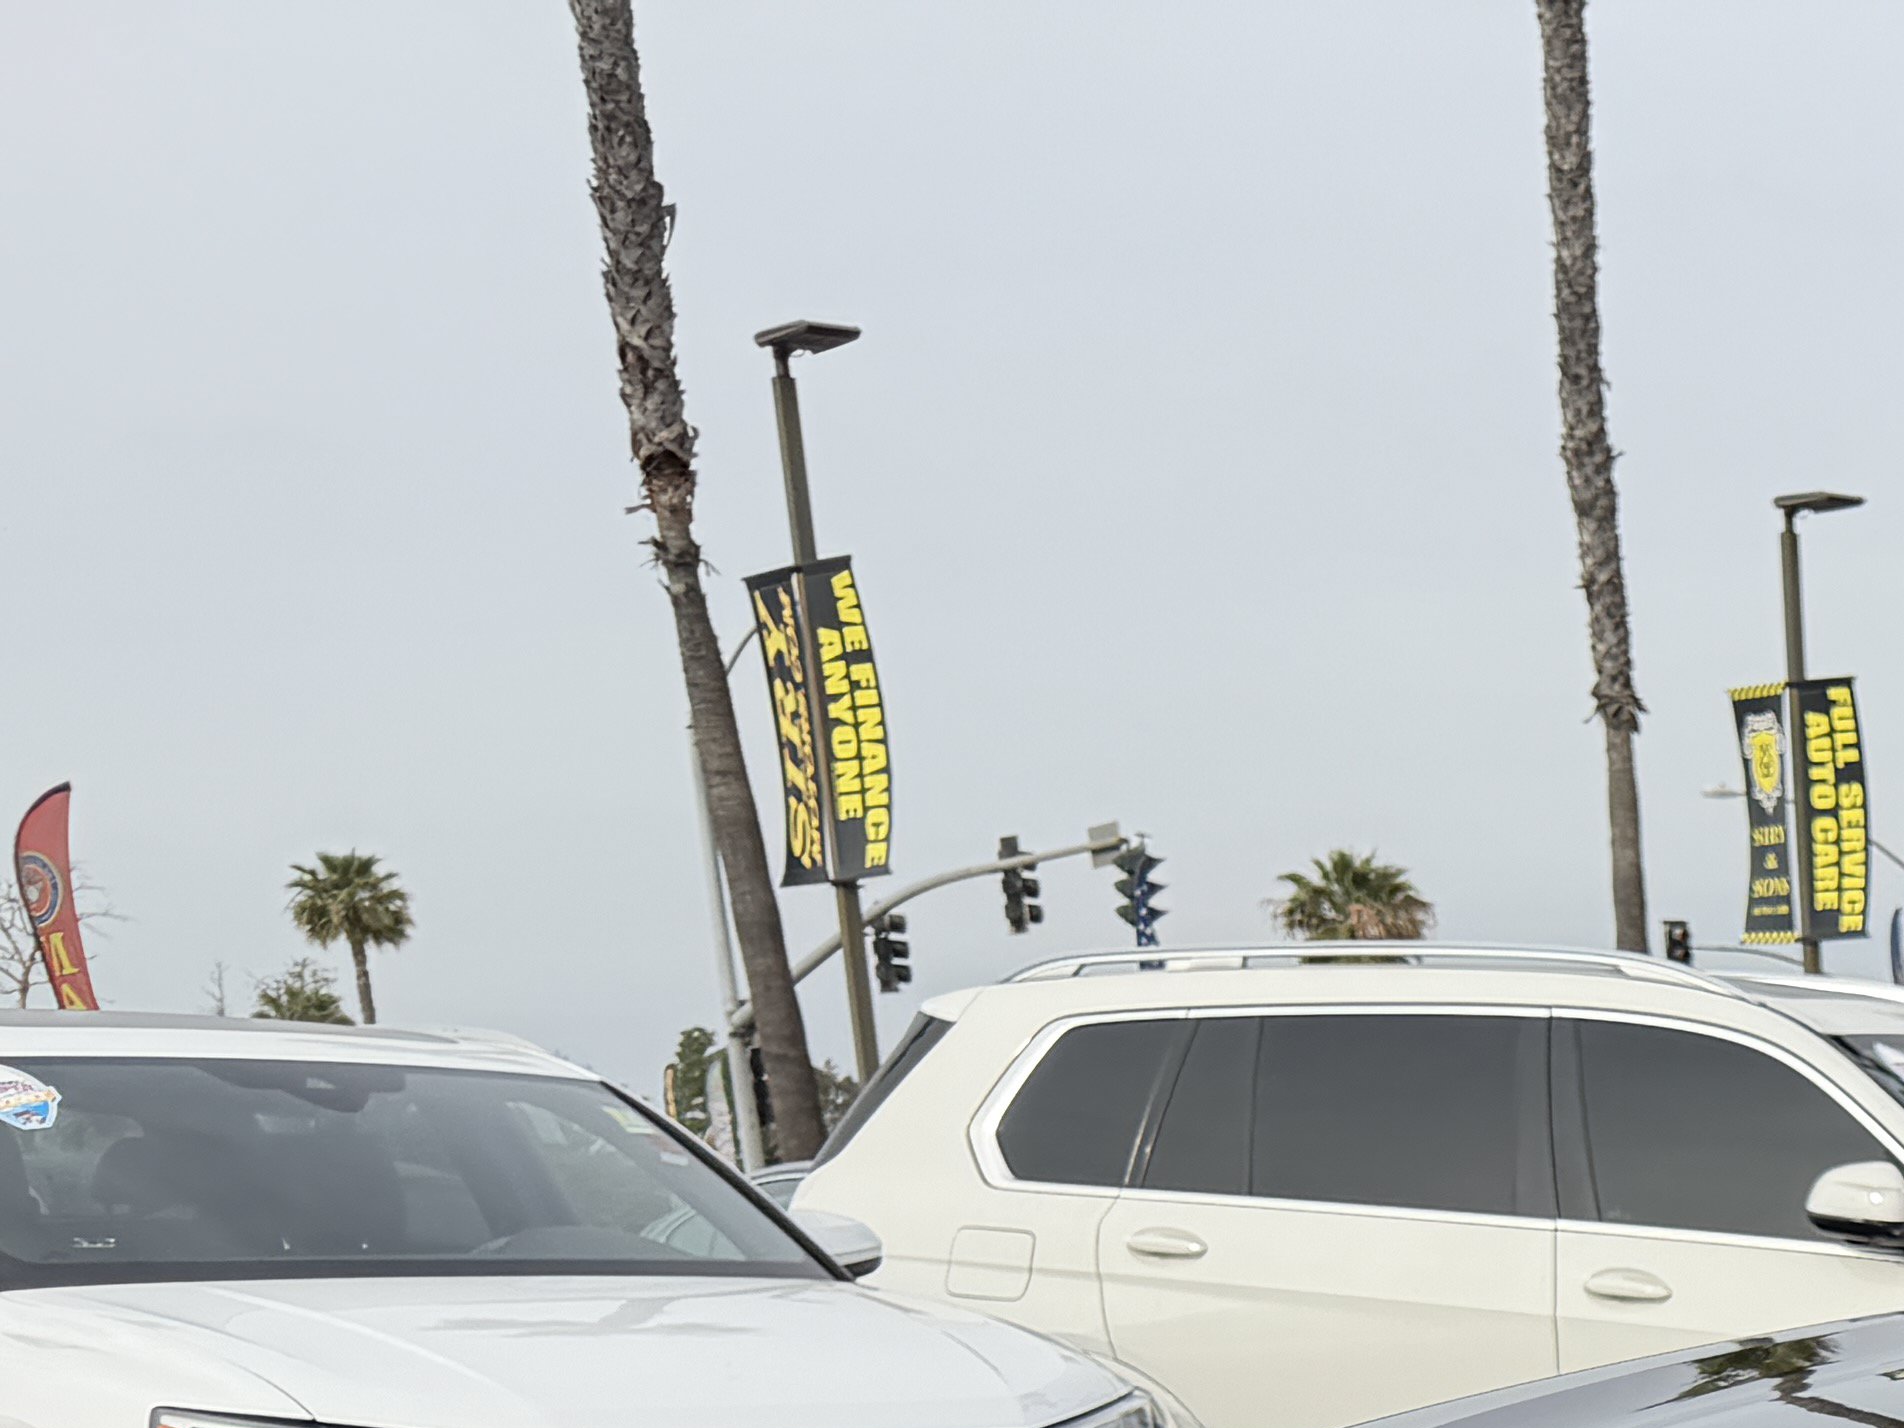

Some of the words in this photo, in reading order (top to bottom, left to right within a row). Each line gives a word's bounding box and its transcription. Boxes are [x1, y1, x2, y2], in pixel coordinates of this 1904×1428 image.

[831, 570, 869, 652] WE
[753, 590, 812, 870] SIRY
[816, 627, 864, 821] ANYONE
[849, 663, 890, 869] FINANCE
[1804, 710, 1837, 810] AUTO
[1826, 686, 1861, 769] FULL
[1811, 816, 1839, 912] CARE
[1838, 781, 1866, 933] SERVICE
